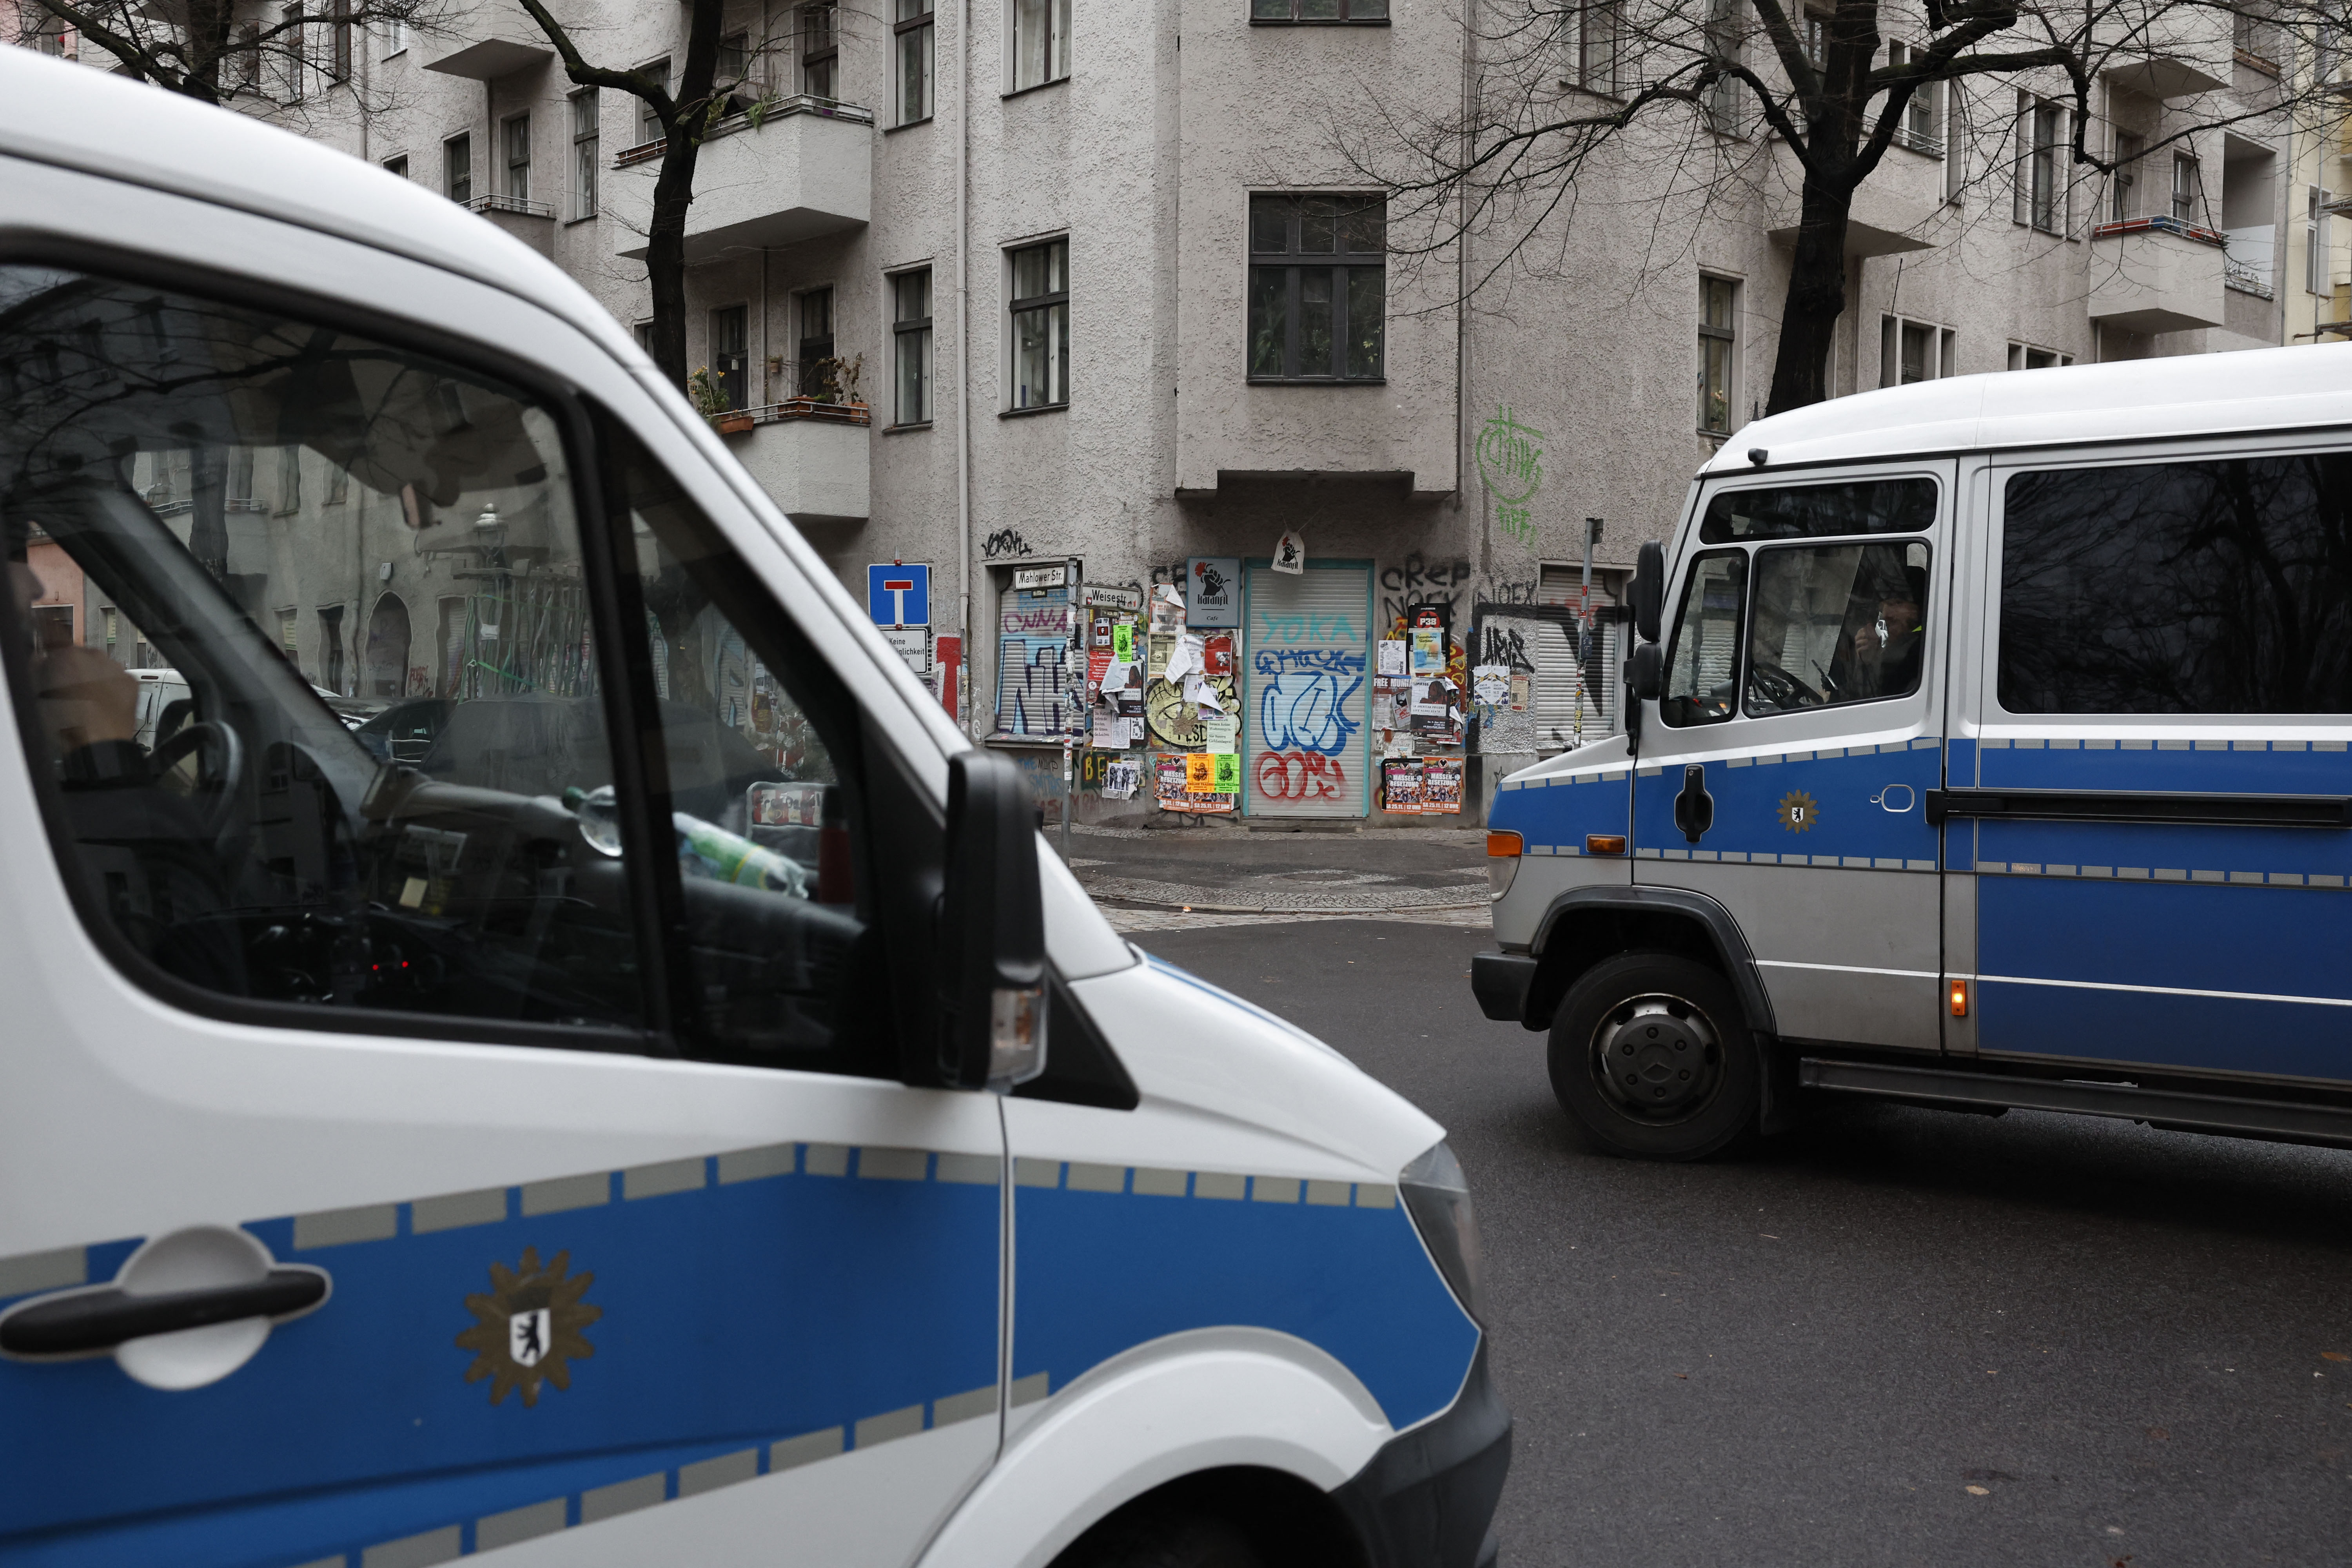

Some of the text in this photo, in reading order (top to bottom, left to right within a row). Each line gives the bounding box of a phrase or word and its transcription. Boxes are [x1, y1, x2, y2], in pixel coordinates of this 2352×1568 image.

[1019, 570, 1062, 584] Mahlower Str.
[1092, 589, 1127, 603] Weisestr.
[1374, 678, 1388, 687] FREE
